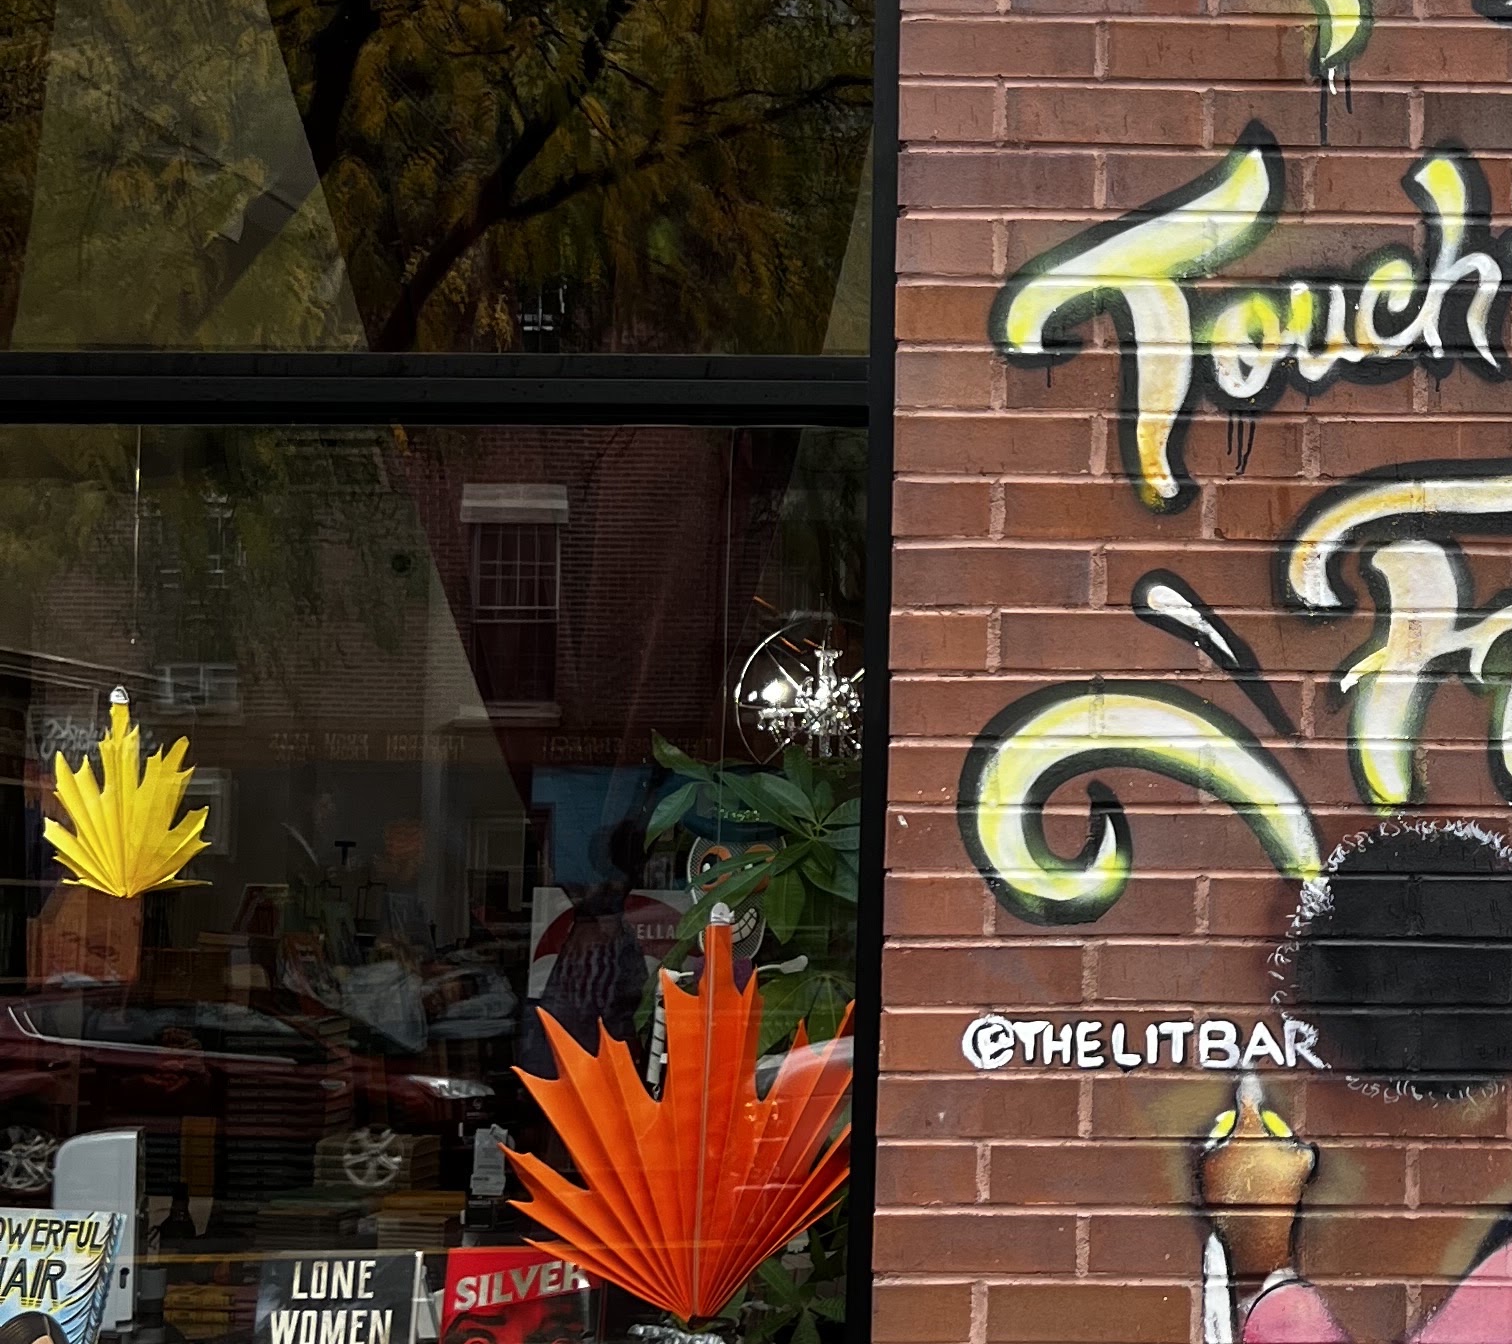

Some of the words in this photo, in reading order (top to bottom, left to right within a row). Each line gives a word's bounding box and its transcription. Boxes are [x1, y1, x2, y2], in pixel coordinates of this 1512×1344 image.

[1003, 144, 1502, 498] Touch
[291, 1259, 376, 1300] LONE
[453, 1259, 591, 1311] SILVER
